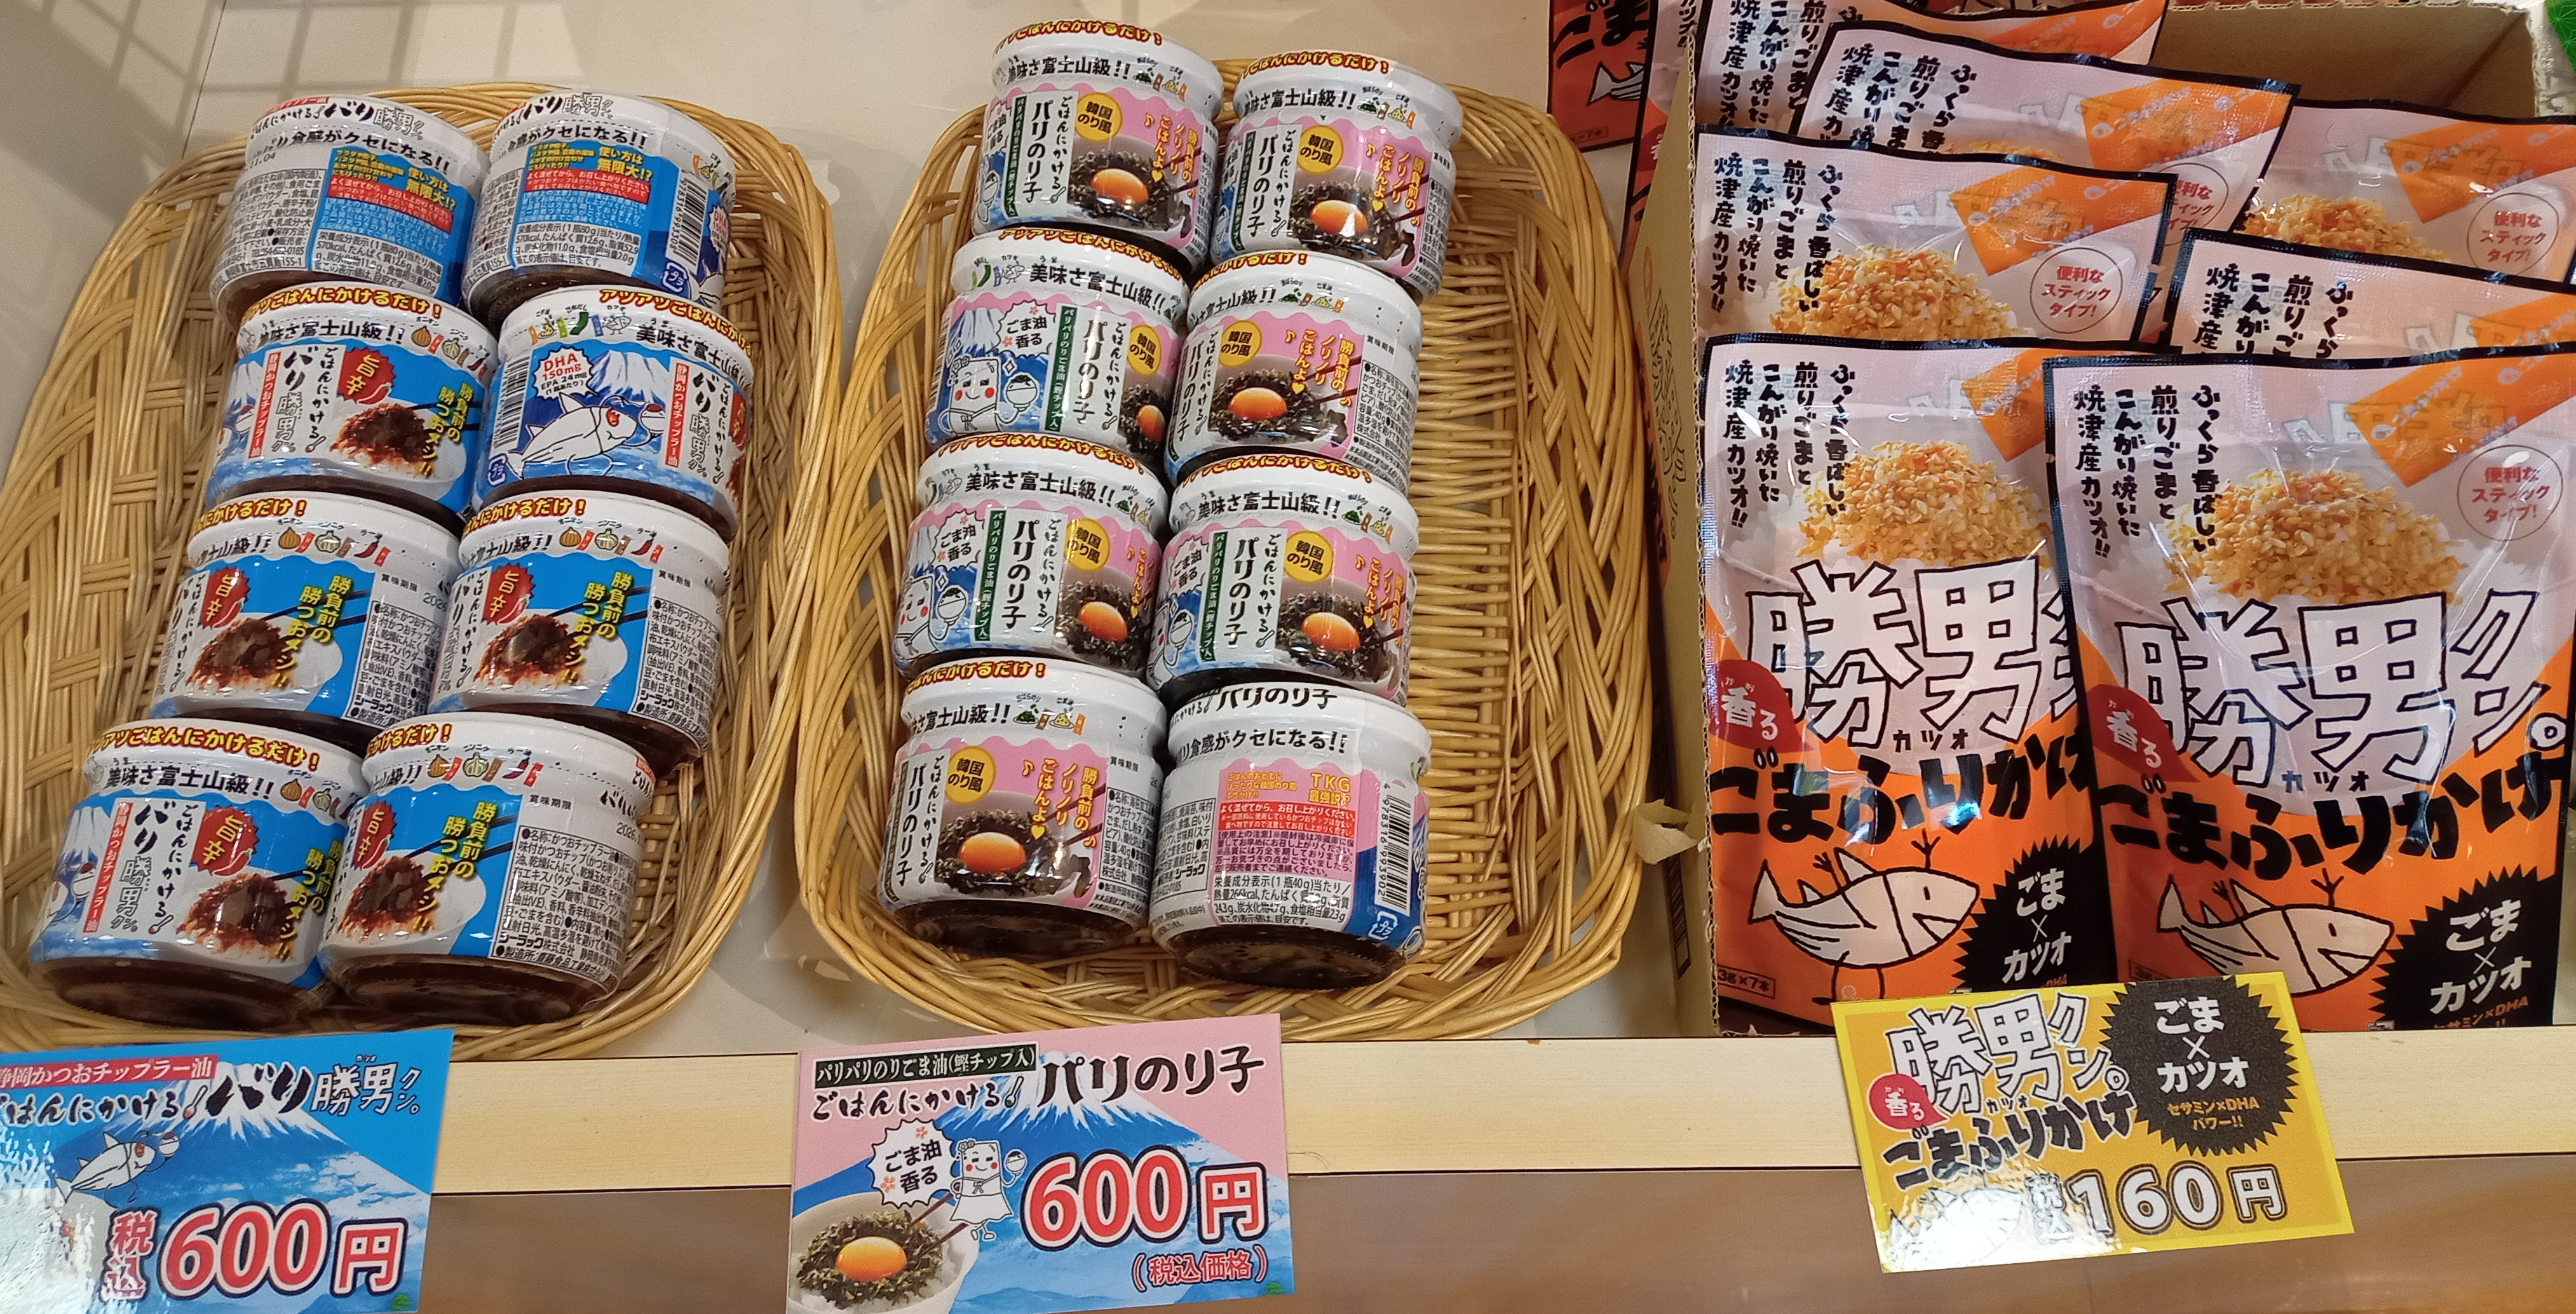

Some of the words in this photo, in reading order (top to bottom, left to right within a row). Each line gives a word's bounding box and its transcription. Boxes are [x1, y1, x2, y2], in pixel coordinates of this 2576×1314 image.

[1078, 116, 1112, 134] のり風
[1086, 100, 1113, 119] 韓国
[599, 147, 644, 165] 使い方は
[1023, 100, 1054, 203] パリのり子
[1051, 95, 1073, 189] ごはんにかける
[1300, 147, 1332, 165] のり風
[1308, 135, 1334, 151] 韓国
[409, 166, 449, 191] 使い方は
[597, 159, 653, 180] 無限大!?
[1248, 135, 1279, 236] パリのり子
[1272, 130, 1296, 223] ごはんにかける
[1373, 144, 1395, 199] ごはんよ
[1392, 153, 1409, 203] ノリノリ
[1711, 152, 1744, 314] 焼津産カツオ!!
[1737, 158, 1774, 293] こんがり焼いた
[1773, 160, 1807, 280] 煎りごまと
[1799, 163, 1843, 313] ふっくら香ばしい
[2479, 229, 2547, 246] スティック
[2493, 211, 2542, 227] 便利な
[2057, 266, 2103, 283] 便利な
[2487, 248, 2530, 262] タイプ!
[1029, 264, 1166, 315] 美味さ富士山級!!
[2042, 284, 2112, 302] スティック
[2049, 300, 2096, 318] タイプ!
[1007, 316, 1048, 334] ごま油
[1016, 334, 1042, 348] 香る
[1137, 332, 1156, 353] 韓国
[1228, 331, 1252, 344] 韓国
[543, 353, 578, 371] DHA
[1105, 322, 1127, 417] ごはんにかける
[1129, 345, 1154, 369] のり風
[1221, 344, 1251, 356] のり風
[1293, 329, 1317, 381] ごはんよ
[1315, 335, 1334, 386] ノリノリ
[1331, 340, 1355, 392] 勝負前の
[346, 354, 379, 394] 旨辛
[541, 378, 559, 389] EPA
[542, 363, 581, 380] 150mg
[1073, 321, 1107, 423] パリのり子
[447, 383, 475, 443] 勝負前の
[665, 363, 688, 466] 静岡かつおチップラー油
[1793, 362, 1819, 485] 煎りごまと
[1723, 359, 1754, 528] 焼津産カツオ!!
[1755, 364, 1786, 503] こんがり焼いた
[1824, 363, 1855, 516] ふっくら香ばしい
[2150, 384, 2181, 520] 煎りごまと
[2073, 383, 2112, 559] 焼津産カツオ!!
[2112, 389, 2146, 538] こんがり焼いた
[2191, 384, 2221, 552] ふっくら香ばしい
[2484, 465, 2540, 484] 便利な
[965, 471, 1115, 507] 美味さ富士山級!!
[1198, 491, 1340, 520] 美味さ富士山級!!
[2472, 485, 2551, 503] スティック
[2483, 505, 2538, 524] タイプ!
[940, 525, 977, 548] ごま油
[948, 543, 972, 562] 香る
[1067, 541, 1101, 564] のり風
[1076, 527, 1102, 550] 韓国
[1296, 541, 1324, 560] 韓国
[1002, 520, 1038, 629] パリのり子
[1038, 518, 1062, 618] ごはんにかける
[1178, 569, 1198, 588] 香る
[1259, 534, 1282, 633] ごはんにかける
[1287, 553, 1324, 575] のり風
[490, 571, 519, 615] 旨辛
[597, 571, 632, 639] 勝負前の
[1224, 538, 1259, 645] パリのり子
[1364, 558, 1381, 615] ごはんよ
[311, 575, 352, 643] 勝負前の
[1746, 555, 2077, 747] 勝男
[1216, 688, 1337, 711] パリのり子
[1721, 686, 1779, 740] 香る
[1893, 728, 1969, 753] カツオ
[2107, 710, 2162, 768] 香る
[105, 765, 275, 799] 美味さ富士山級!!
[948, 775, 984, 792] のり風
[957, 757, 985, 776] 韓国
[1311, 772, 1351, 792] TKG
[2282, 771, 2369, 792] カツオ
[529, 795, 572, 810] 賞味期限
[1031, 759, 1057, 823] ごはんよ
[1054, 764, 1077, 825] ノリノリ
[1074, 767, 1099, 831] 勝負前の
[896, 764, 928, 886] パリのり子
[2100, 756, 2554, 881] ごまふりかけ
[202, 816, 243, 865] 旨辛
[453, 801, 496, 879] 勝負前の
[2016, 867, 2066, 918] ごま
[2445, 900, 2522, 952] ごま
[2002, 931, 2071, 983] カツオ
[2430, 956, 2532, 1015] カツオ
[2154, 995, 2225, 1035] ごま
[817, 1045, 1036, 1085] パリパリのりごま油(鰹チップ入)
[1041, 1045, 1266, 1104] パリのり子
[2159, 1055, 2249, 1094] カツオ
[813, 1083, 1003, 1120] ごはんにかける
[1885, 1088, 1925, 1120] 香る
[1986, 1096, 2030, 1111] カツオ
[2167, 1098, 2260, 1118] セサミン×DHA
[1883, 1090, 2138, 1190] ごまふりかけ
[2193, 1115, 2244, 1130] パワー!!
[885, 1140, 942, 1174] ごま油
[901, 1168, 939, 1194] 香る
[101, 1209, 158, 1300] 税込
[1133, 1245, 1268, 1291] (税込価格)
